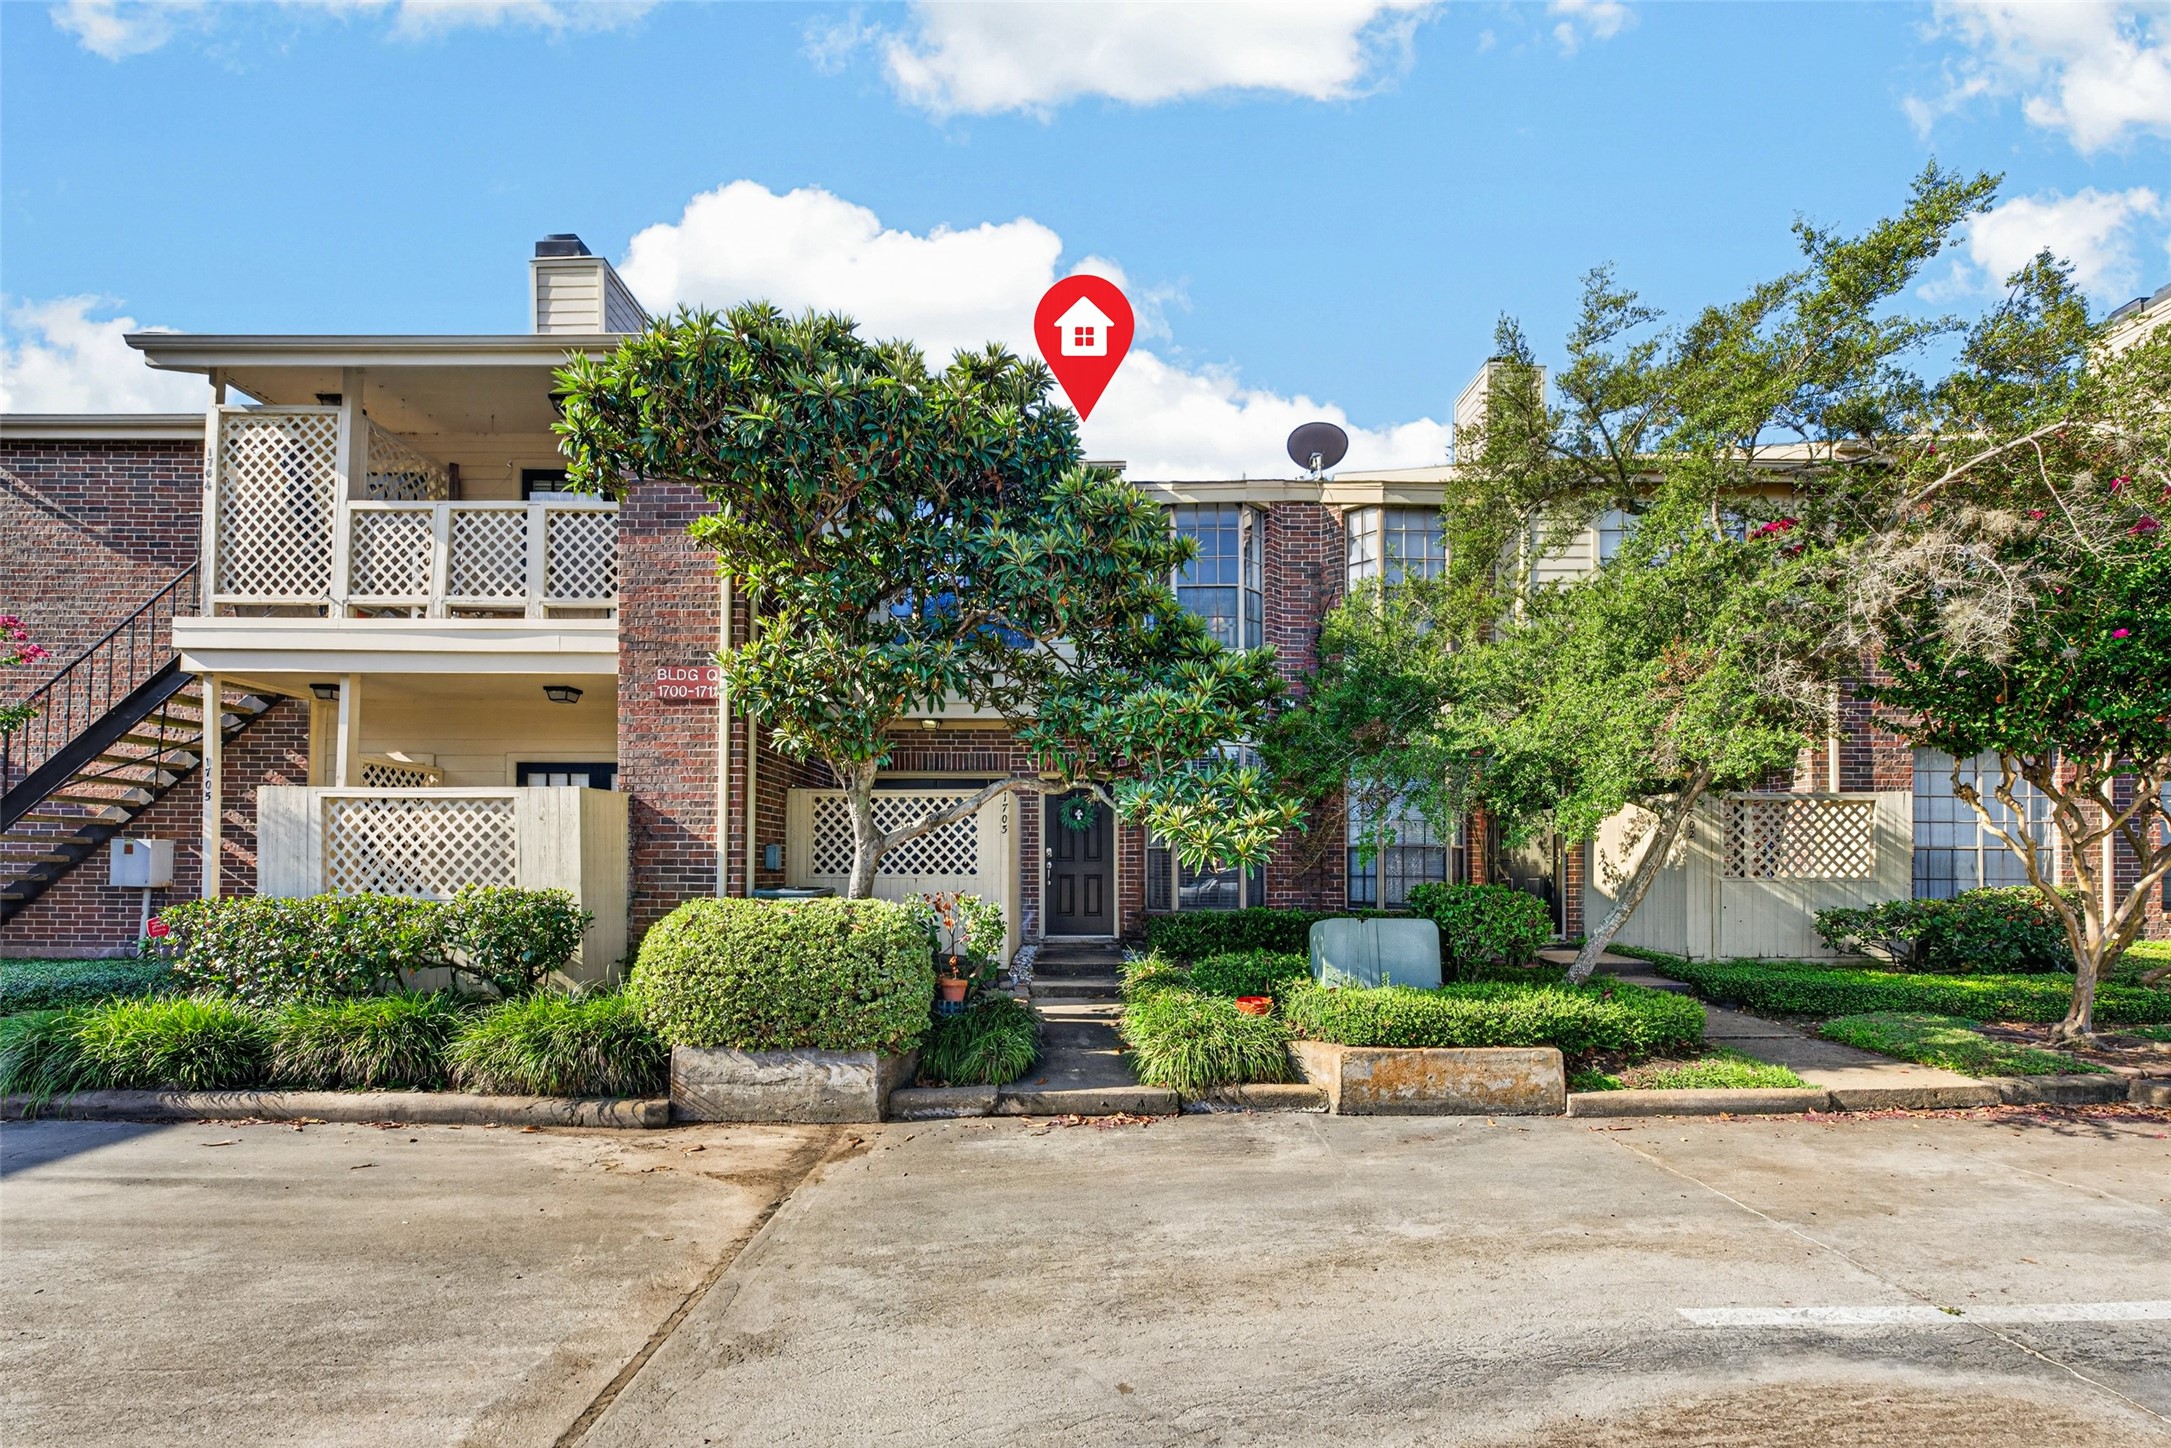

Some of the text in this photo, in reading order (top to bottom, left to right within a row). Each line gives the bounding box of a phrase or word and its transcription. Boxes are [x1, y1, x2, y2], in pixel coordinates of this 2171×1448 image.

[657, 668, 718, 681] BLDG Q
[204, 757, 212, 802] 1705
